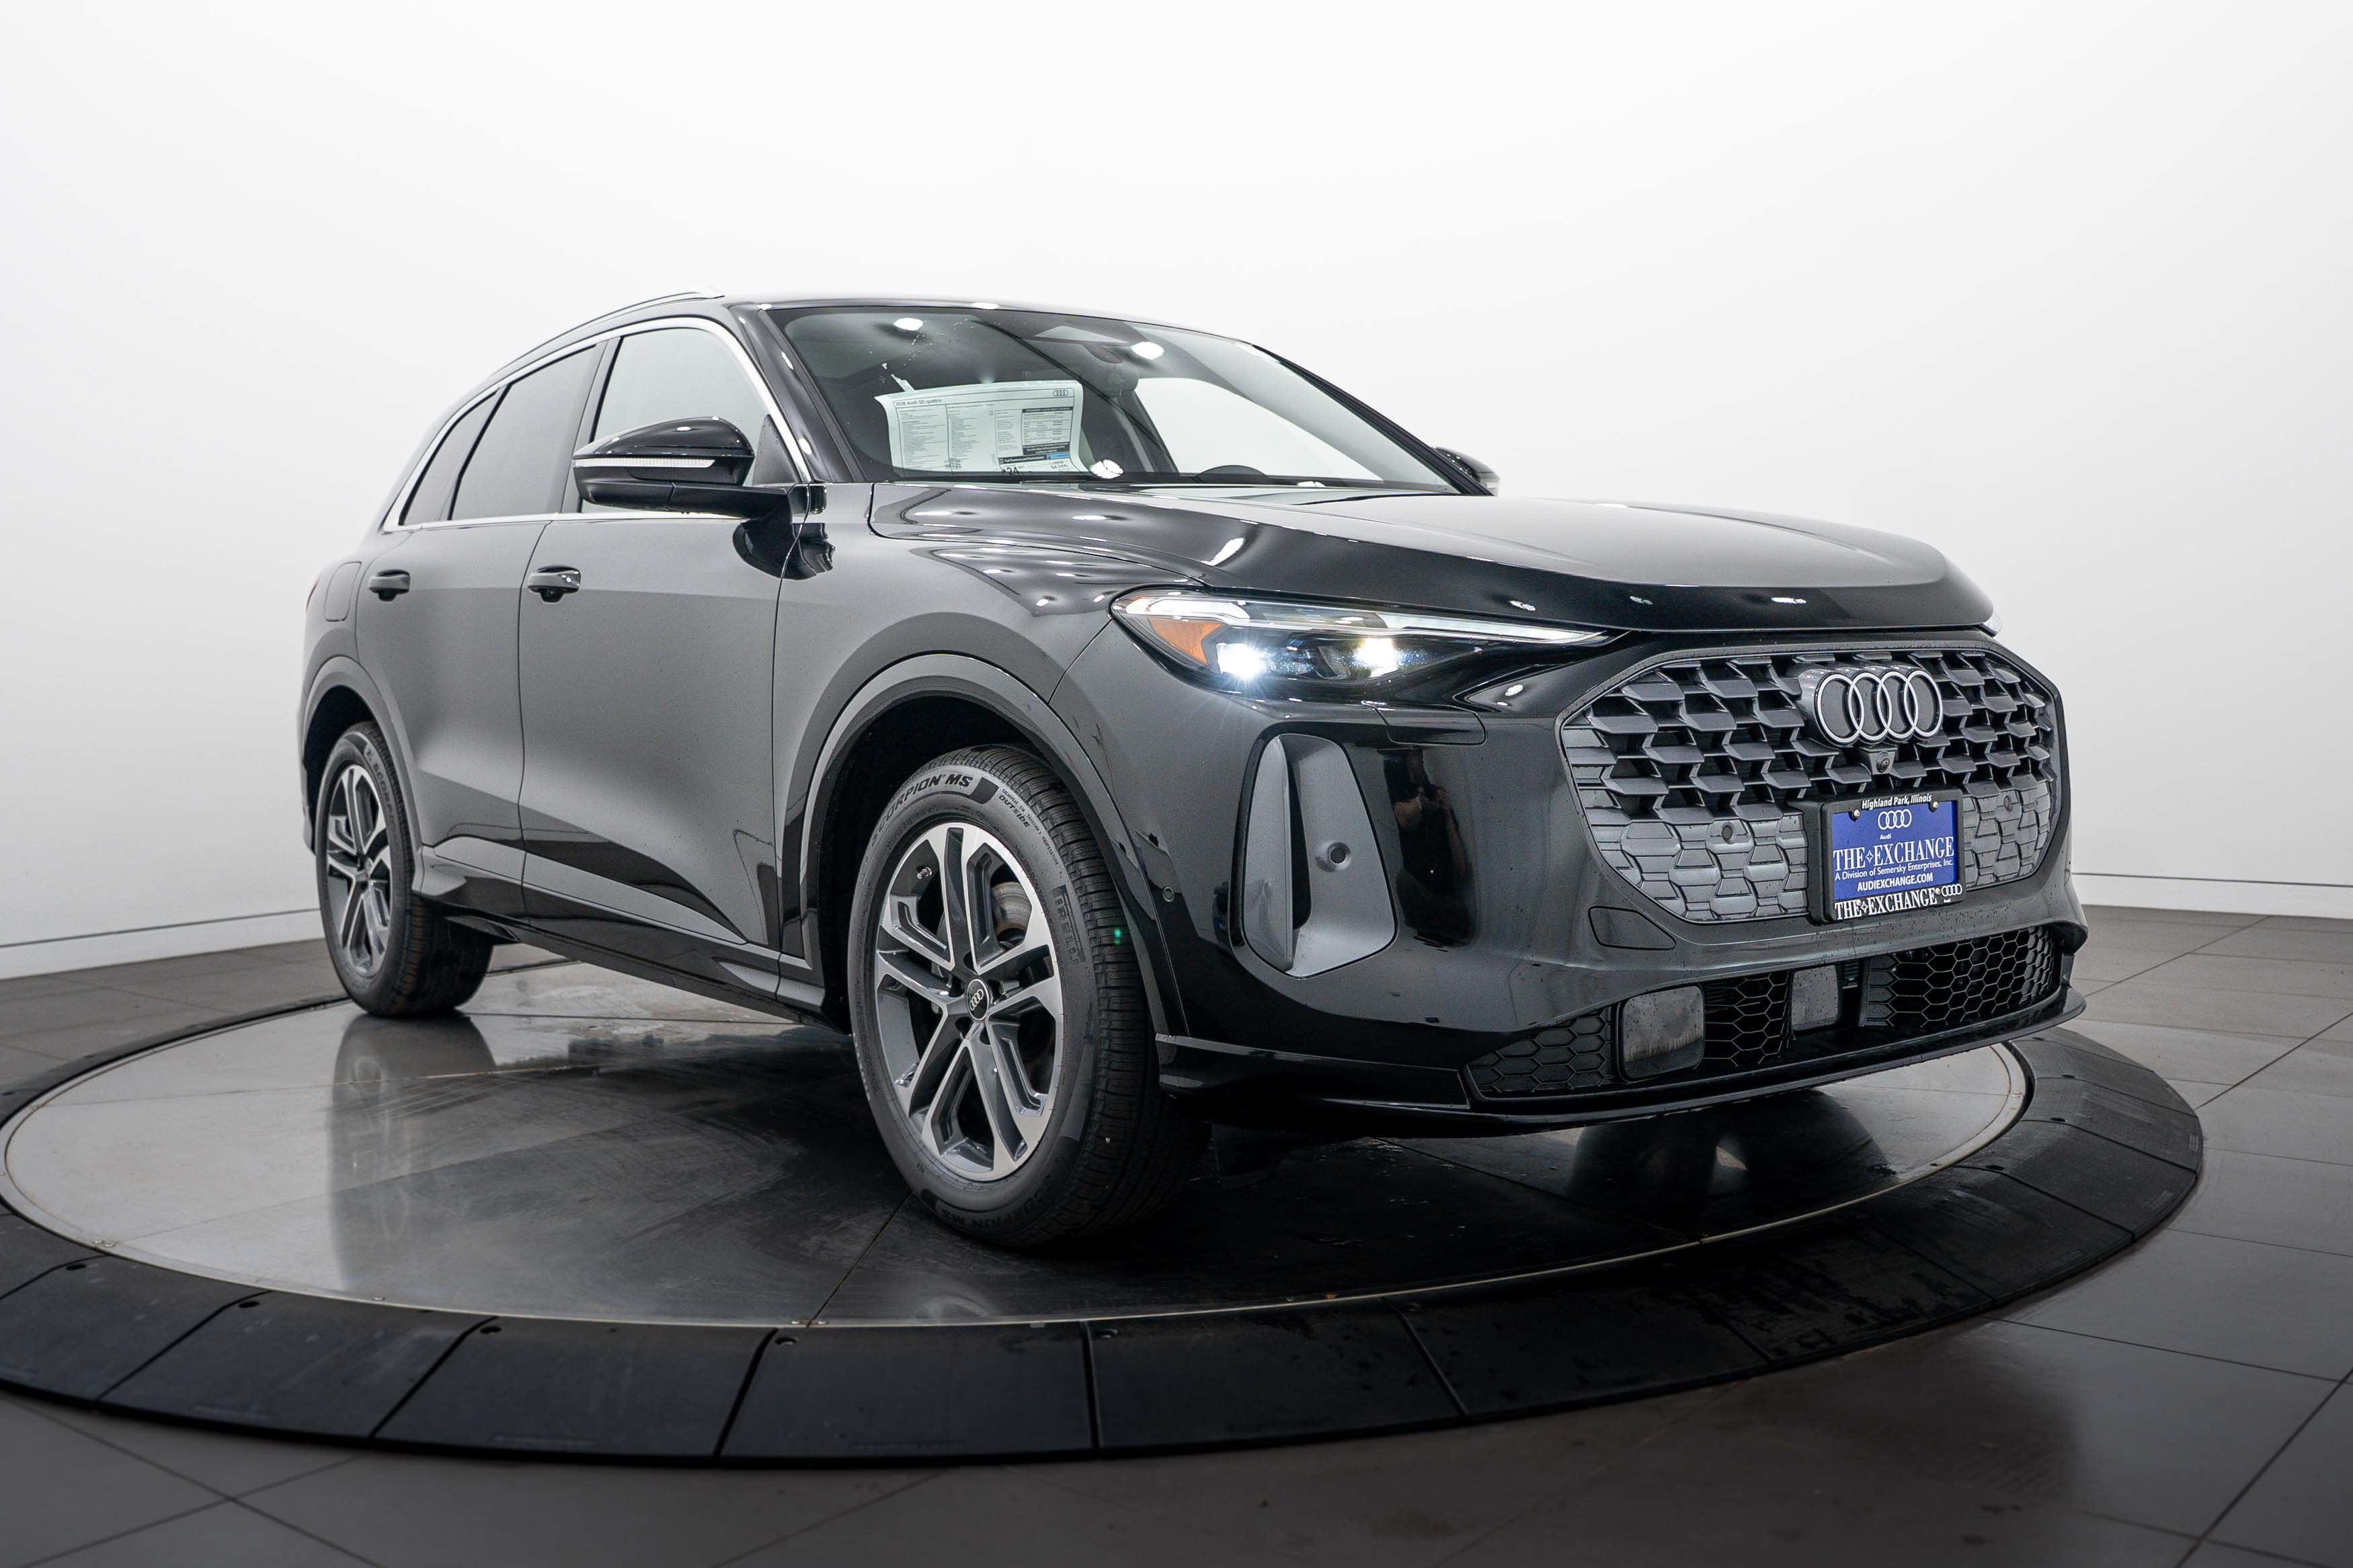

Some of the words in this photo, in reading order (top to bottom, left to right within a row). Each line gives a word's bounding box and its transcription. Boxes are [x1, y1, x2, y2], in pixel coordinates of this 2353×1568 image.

[872, 774, 943, 846] SCORPION
[945, 774, 973, 787] MS
[998, 794, 1031, 828] OUTSIDE
[1862, 796, 1893, 811] Highland
[1893, 795, 1910, 805] Park,
[1911, 792, 1932, 804] Illinois
[1833, 847, 1866, 872] THE
[1873, 836, 1954, 866] EXCHANGE
[1835, 873, 1841, 881] A
[1842, 870, 1867, 880] Division
[1869, 868, 1877, 876] of
[1877, 864, 1907, 875] Semersky
[1908, 861, 1942, 872] Enterprises,
[1944, 858, 1954, 866] Inc.
[1857, 872, 1933, 892] AUDIEXCHANGE.COM
[1834, 899, 1862, 920] THE
[1868, 887, 1938, 915] EXCHANGE
